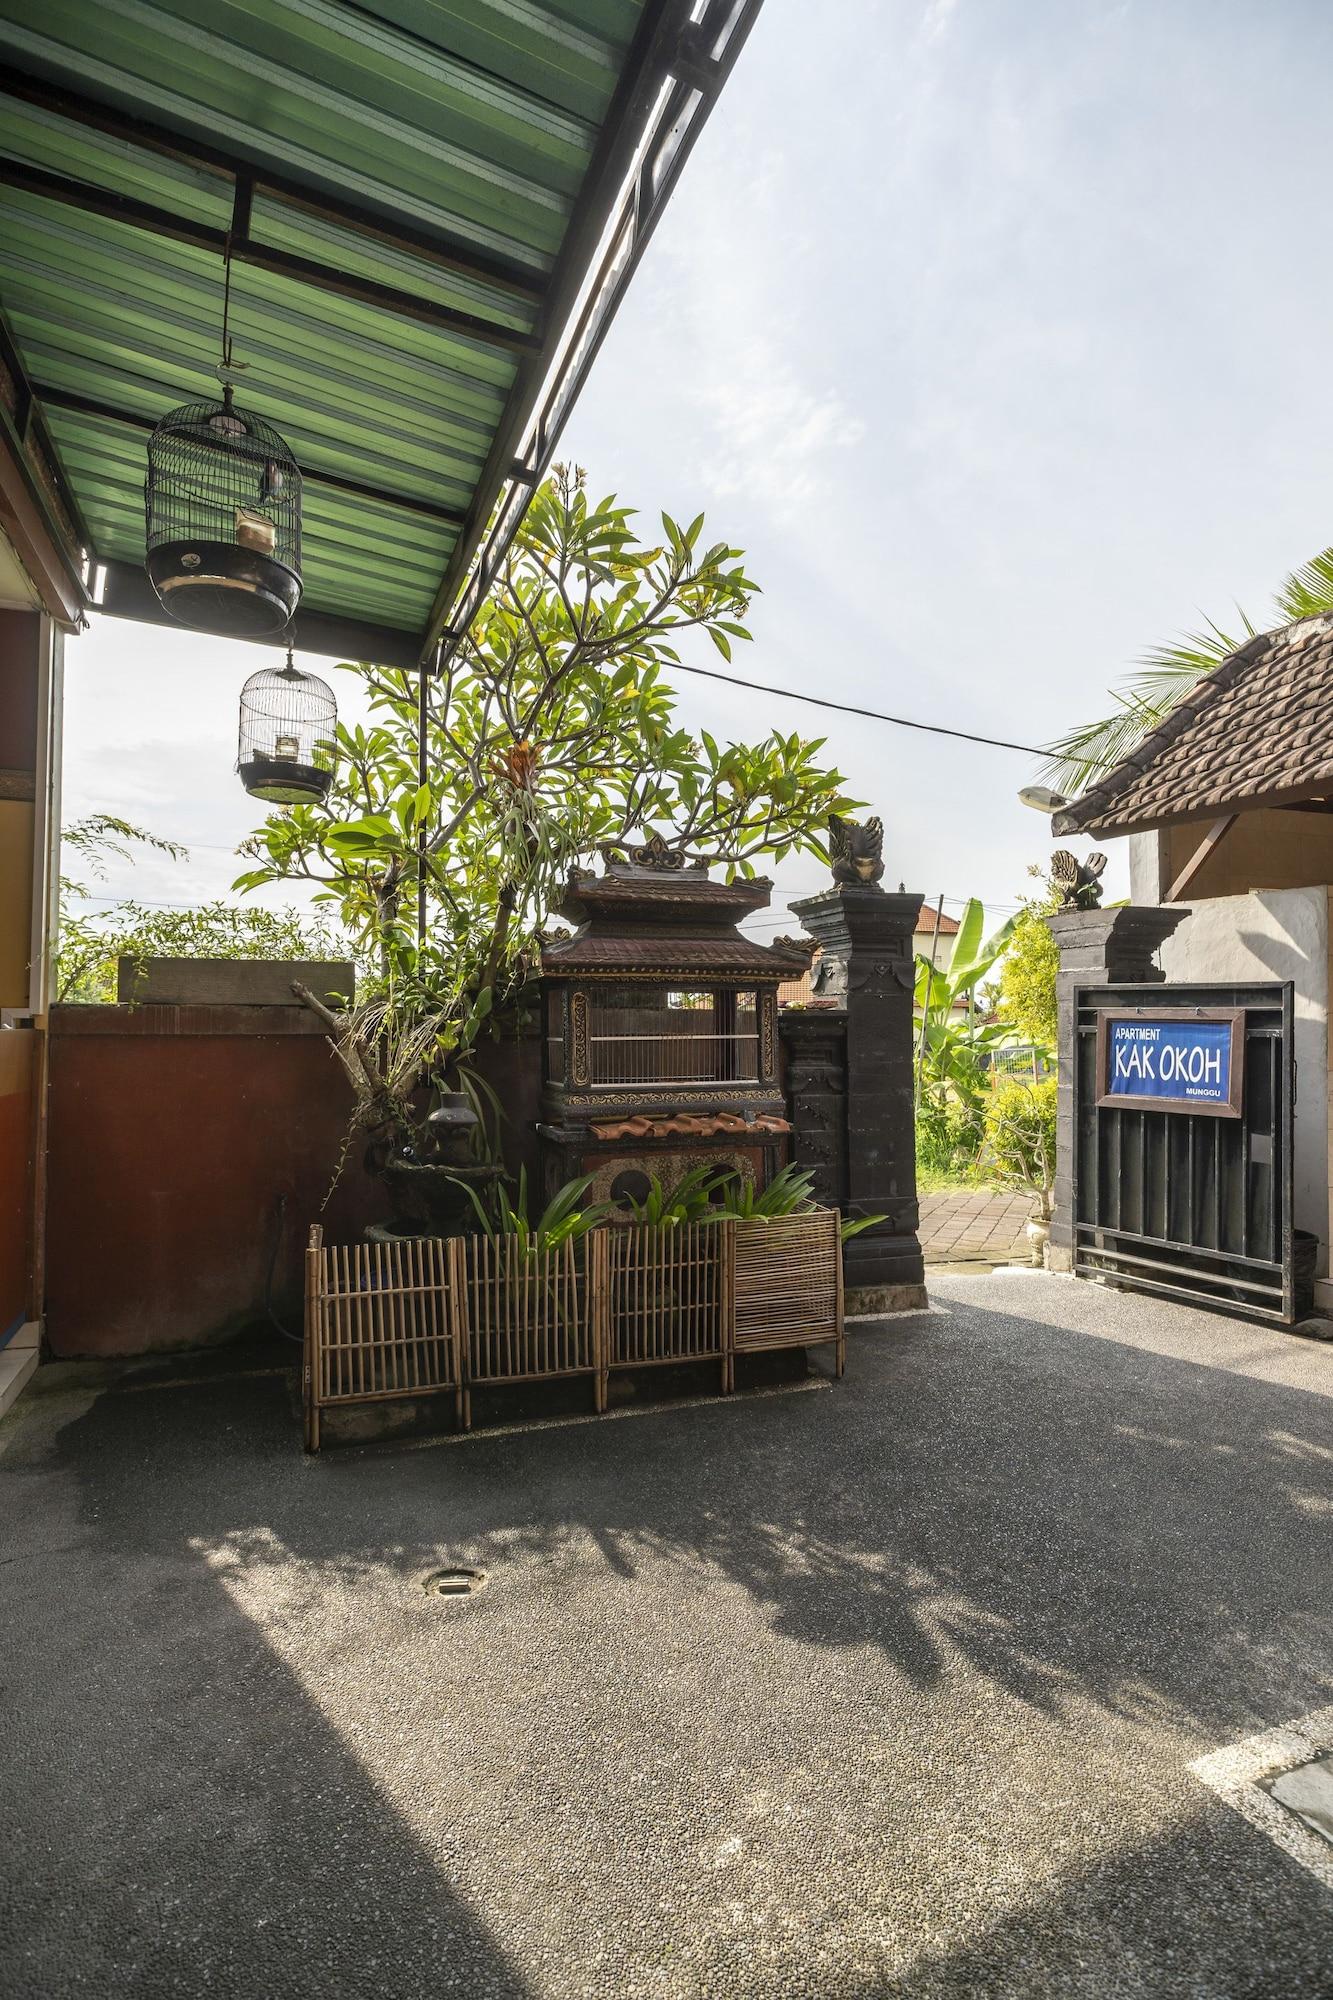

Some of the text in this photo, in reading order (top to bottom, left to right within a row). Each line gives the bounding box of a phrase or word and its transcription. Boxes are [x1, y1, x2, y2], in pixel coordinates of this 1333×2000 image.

[1115, 1027, 1161, 1041] APARTMENT
[1115, 1044, 1221, 1084] KAK OKOH
[1185, 1087, 1221, 1097] MUNGGU
